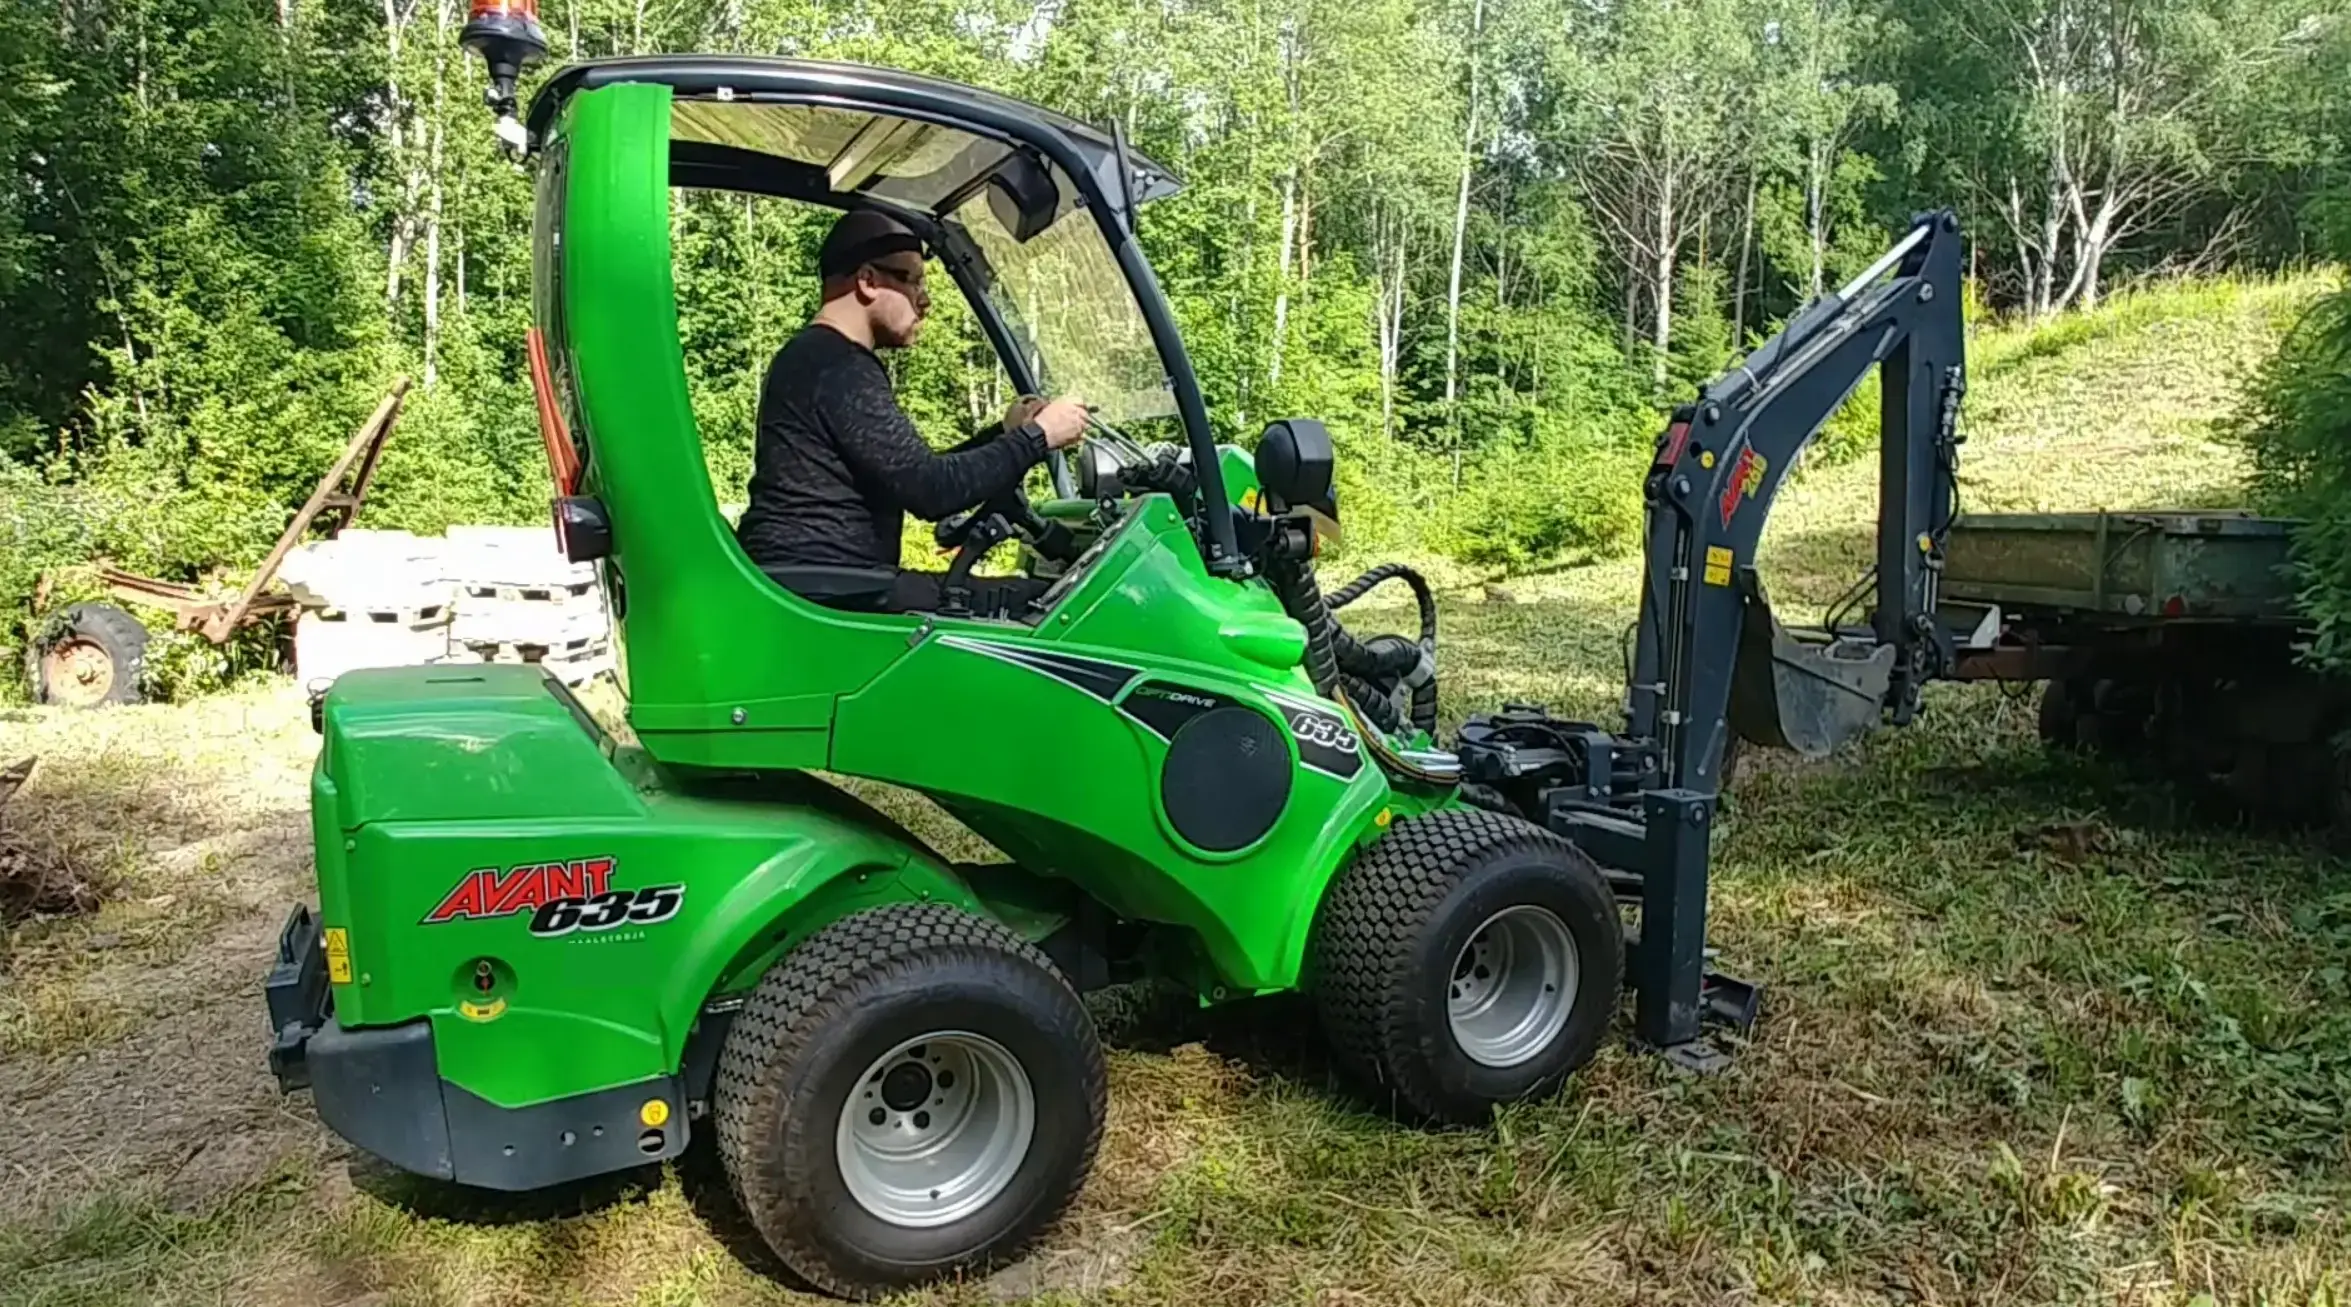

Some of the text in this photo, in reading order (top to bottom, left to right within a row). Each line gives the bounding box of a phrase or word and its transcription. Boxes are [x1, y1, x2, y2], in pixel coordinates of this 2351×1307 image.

[1719, 443, 1755, 532] AVANT
[1135, 687, 1217, 708] OPTIDRIVE
[1291, 713, 1359, 753] 635
[419, 854, 617, 925] AVANT
[527, 881, 686, 938] 635
